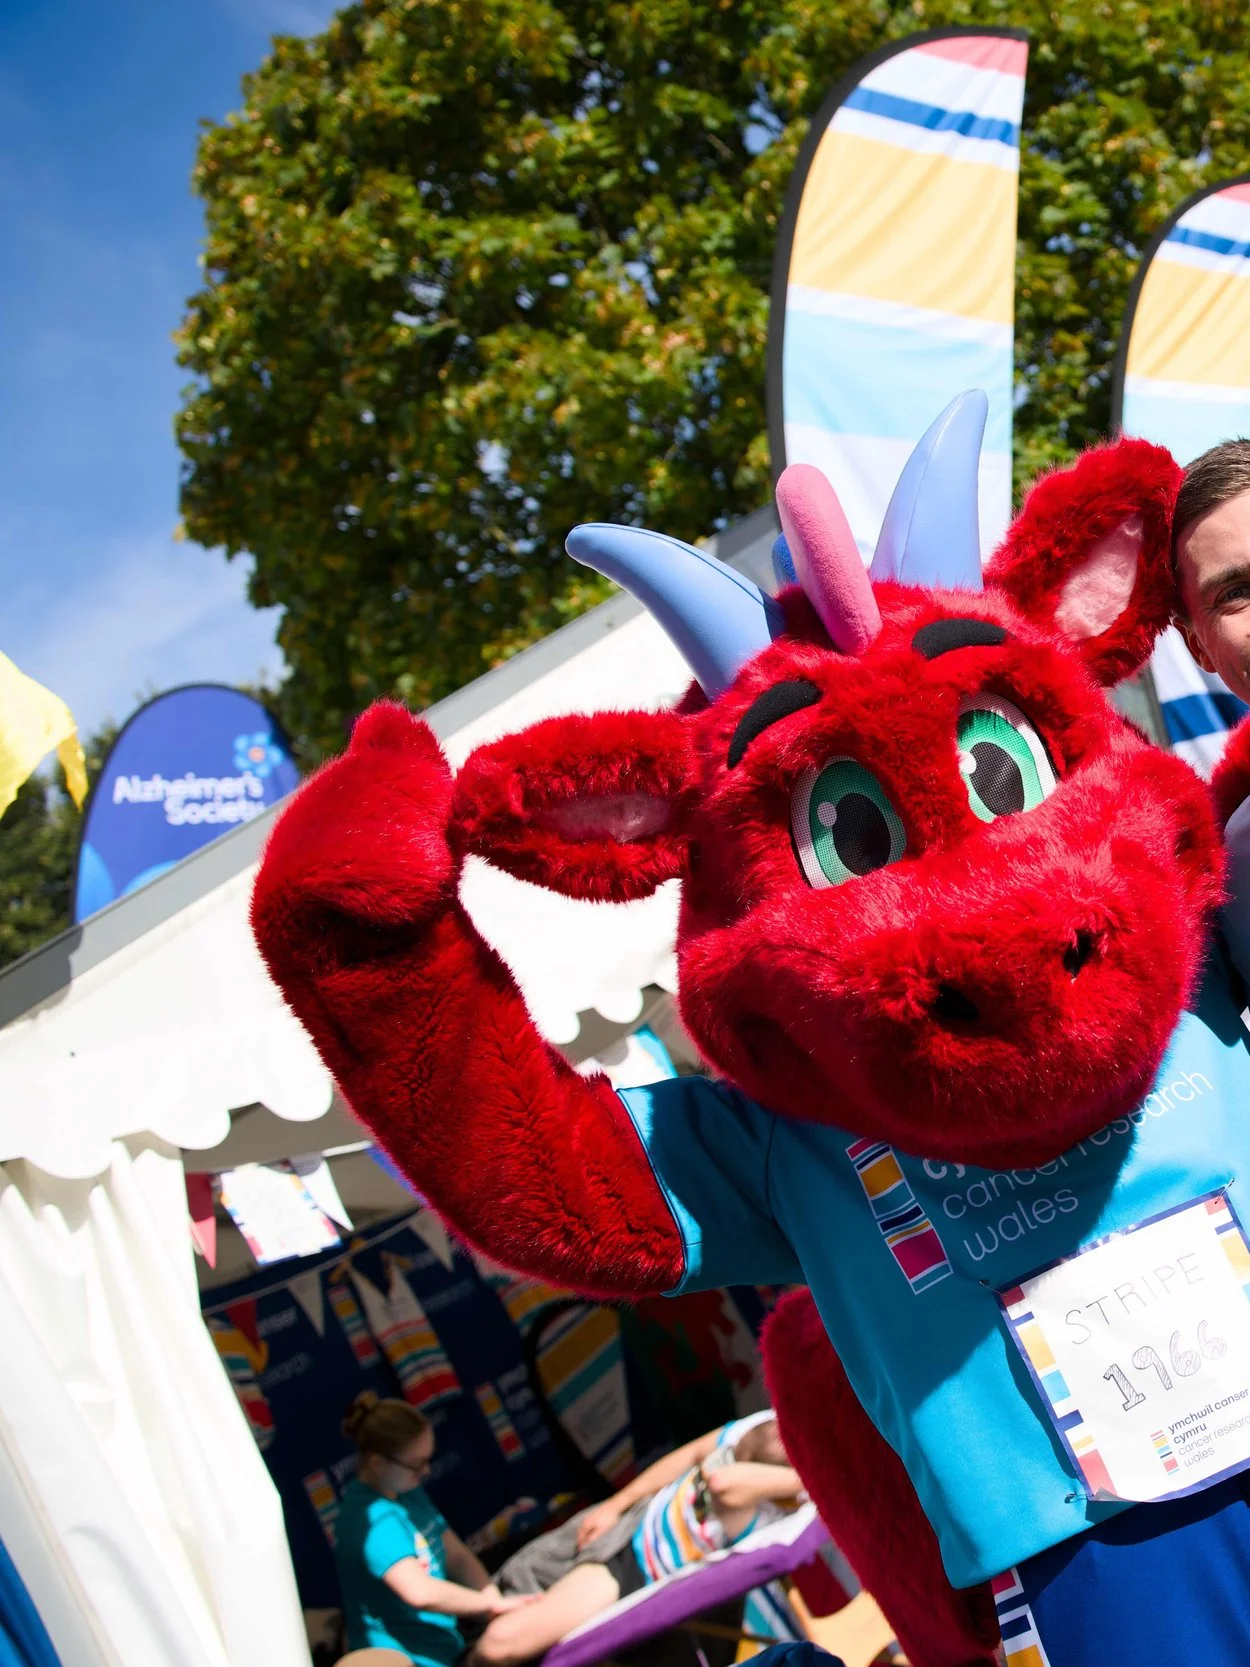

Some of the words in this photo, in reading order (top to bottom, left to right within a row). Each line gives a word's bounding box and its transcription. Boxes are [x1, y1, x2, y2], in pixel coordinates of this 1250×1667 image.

[112, 770, 264, 805] Alzheimer's
[963, 1188, 1079, 1262] wales
[1065, 1253, 1204, 1345] STRIPE
[1103, 1320, 1228, 1412] 1966
[1168, 1404, 1214, 1435] ymchwil
[1214, 1388, 1249, 1411] canser
[1173, 1422, 1207, 1445] cymru
[1178, 1433, 1213, 1456] cancer
[1183, 1446, 1215, 1468] wales
